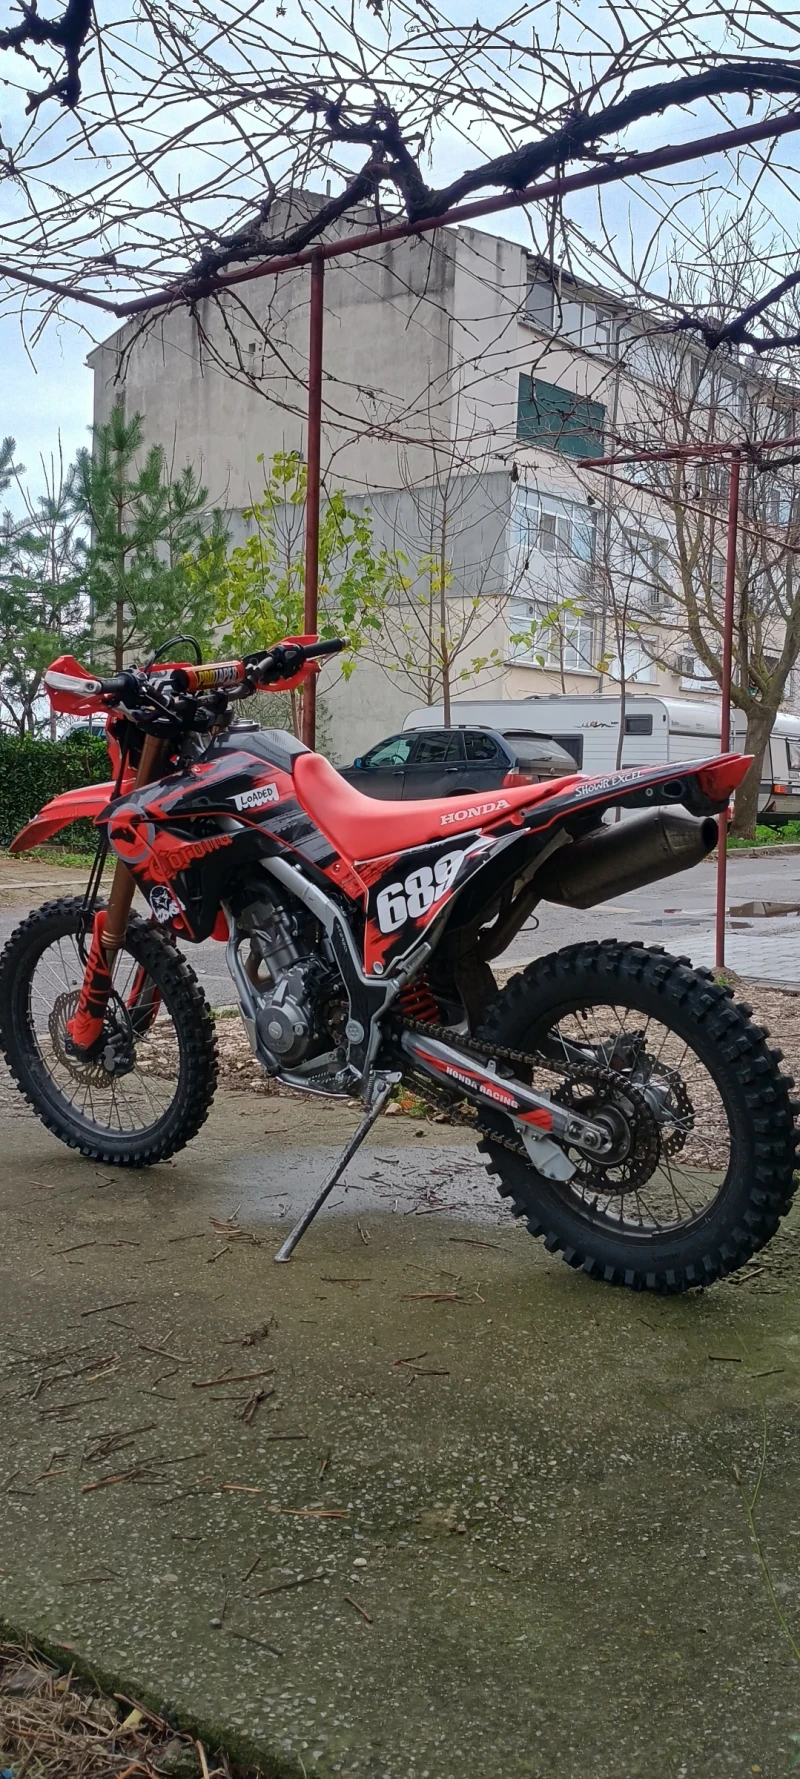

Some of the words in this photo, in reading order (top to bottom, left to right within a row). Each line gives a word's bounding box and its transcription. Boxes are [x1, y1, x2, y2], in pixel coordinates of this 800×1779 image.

[612, 771, 645, 786] EXCEL
[240, 788, 273, 806] LOADED
[440, 799, 512, 826] HONDA
[376, 849, 464, 934] 689
[446, 1066, 478, 1090] HONDA
[479, 1085, 520, 1109] RACING
